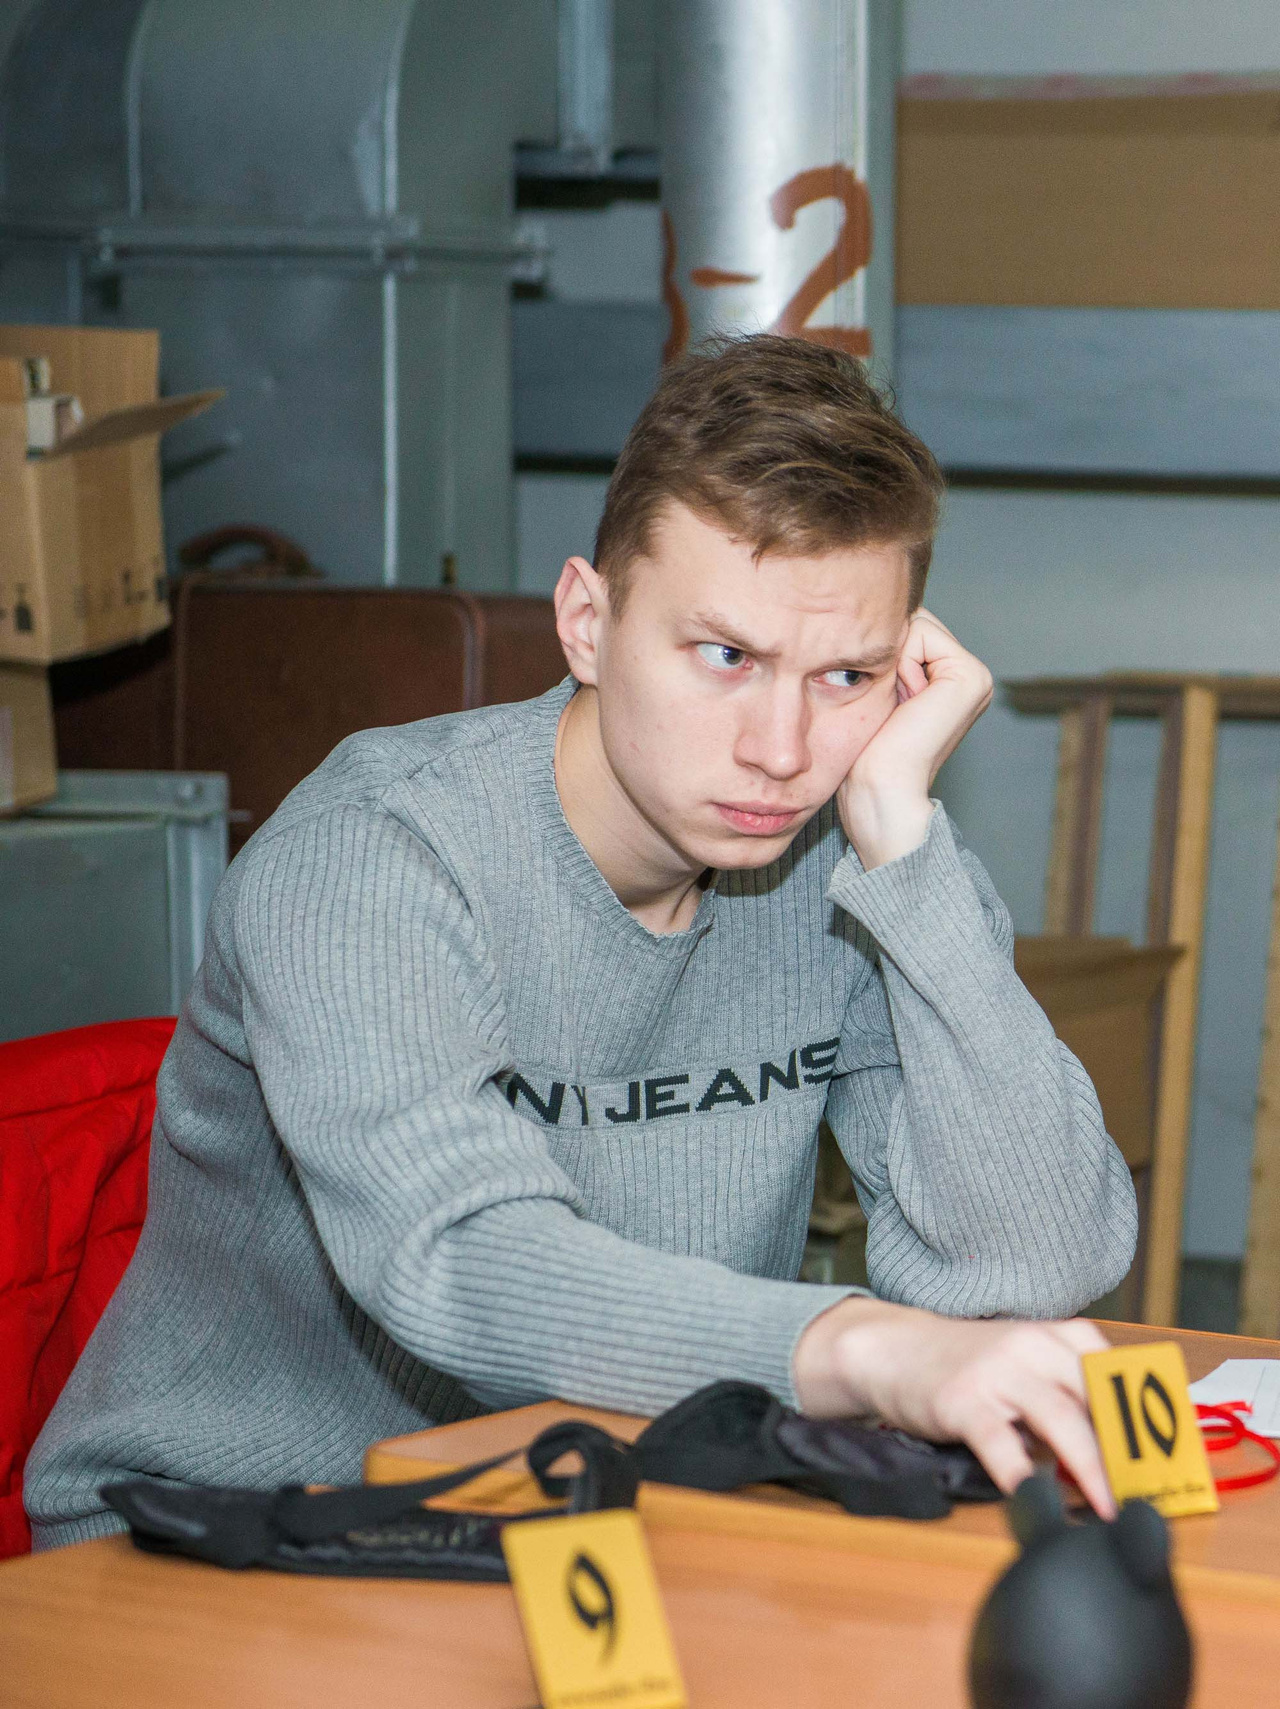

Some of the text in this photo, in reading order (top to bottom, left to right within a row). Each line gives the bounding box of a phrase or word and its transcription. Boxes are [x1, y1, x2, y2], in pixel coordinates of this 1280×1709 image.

[661, 162, 873, 362] -2
[605, 1036, 841, 1123] JEANS
[1110, 1371, 1177, 1460] 10
[566, 1552, 618, 1666] 9
